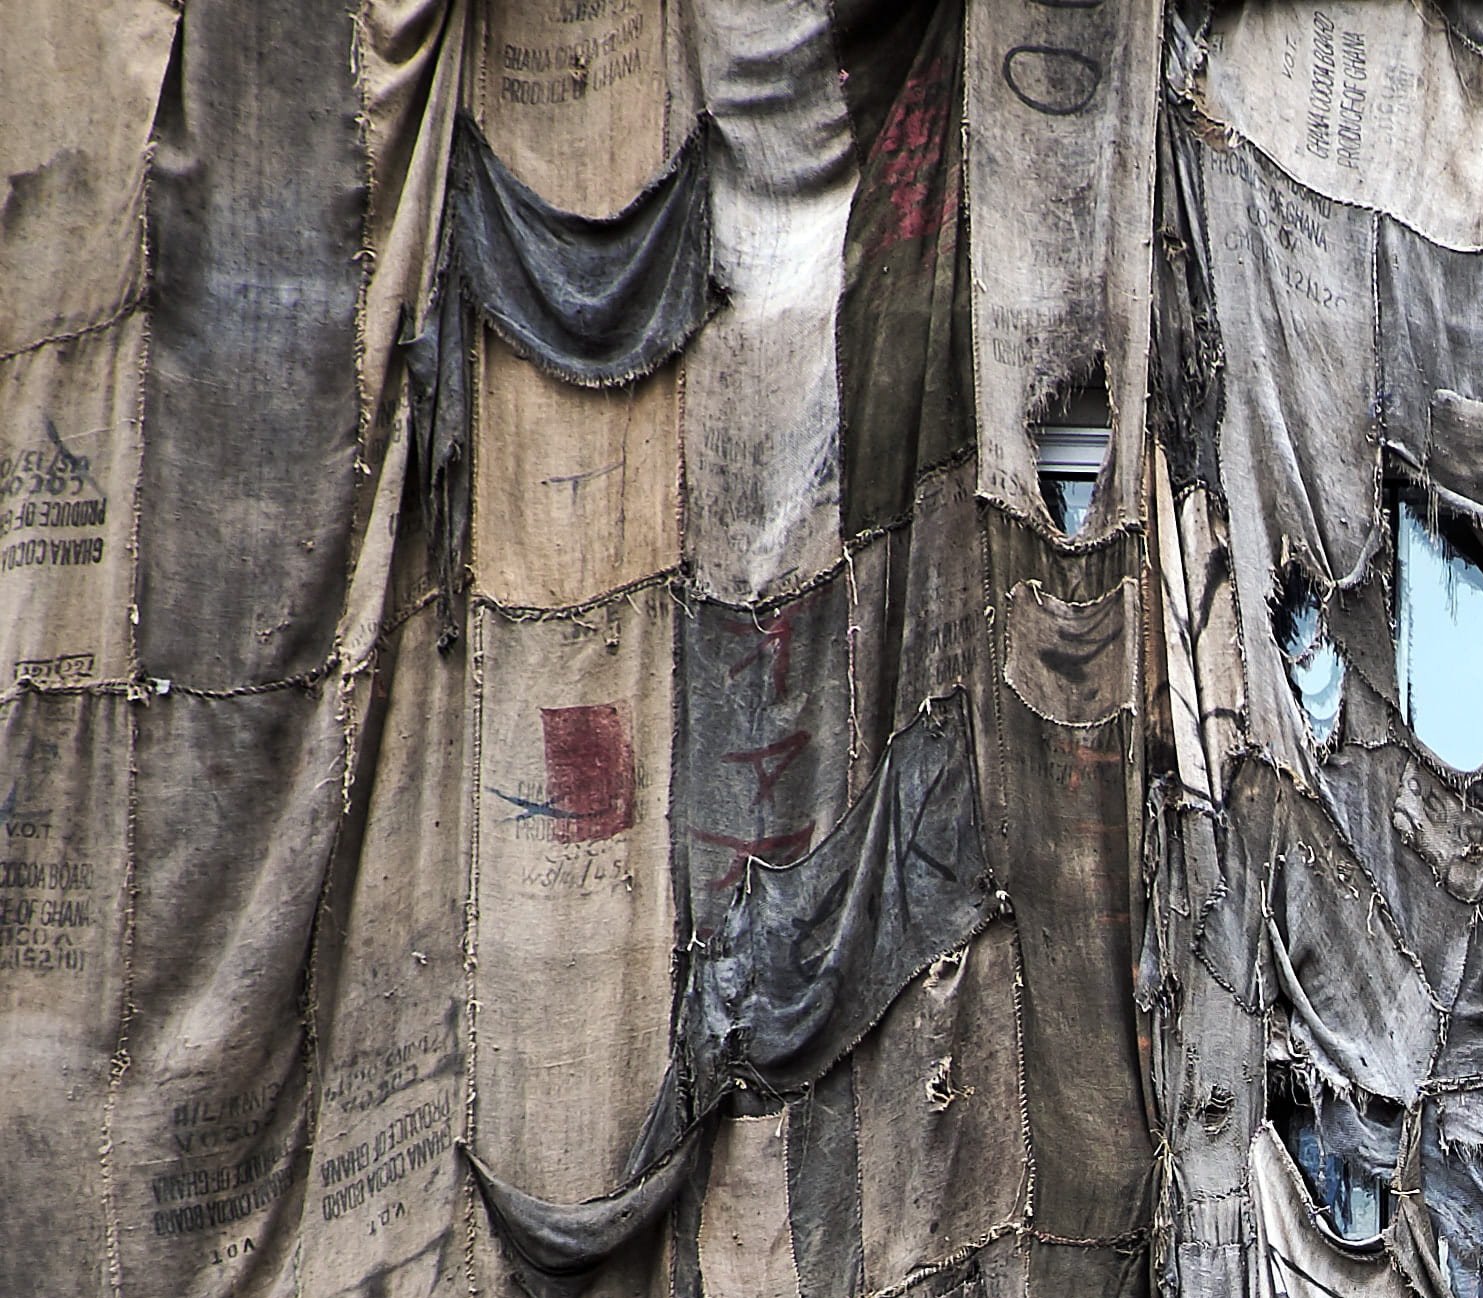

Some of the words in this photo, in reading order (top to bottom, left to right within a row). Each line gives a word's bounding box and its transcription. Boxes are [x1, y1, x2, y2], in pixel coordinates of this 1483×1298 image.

[1312, 10, 1335, 68] BOARD
[1341, 31, 1367, 81] GHANA
[1309, 64, 1336, 113] COCOA
[1305, 112, 1330, 159] GHANA
[1336, 98, 1362, 169] PRODUCE
[38, 498, 107, 528] PRODUCE
[49, 537, 104, 566] GHANA
[388, 1089, 450, 1151] PRODUCE
[320, 1143, 370, 1189] GHANA
[407, 1122, 452, 1172] GHANA
[367, 1152, 406, 1198] COCOA
[322, 1178, 365, 1222] BOARD
